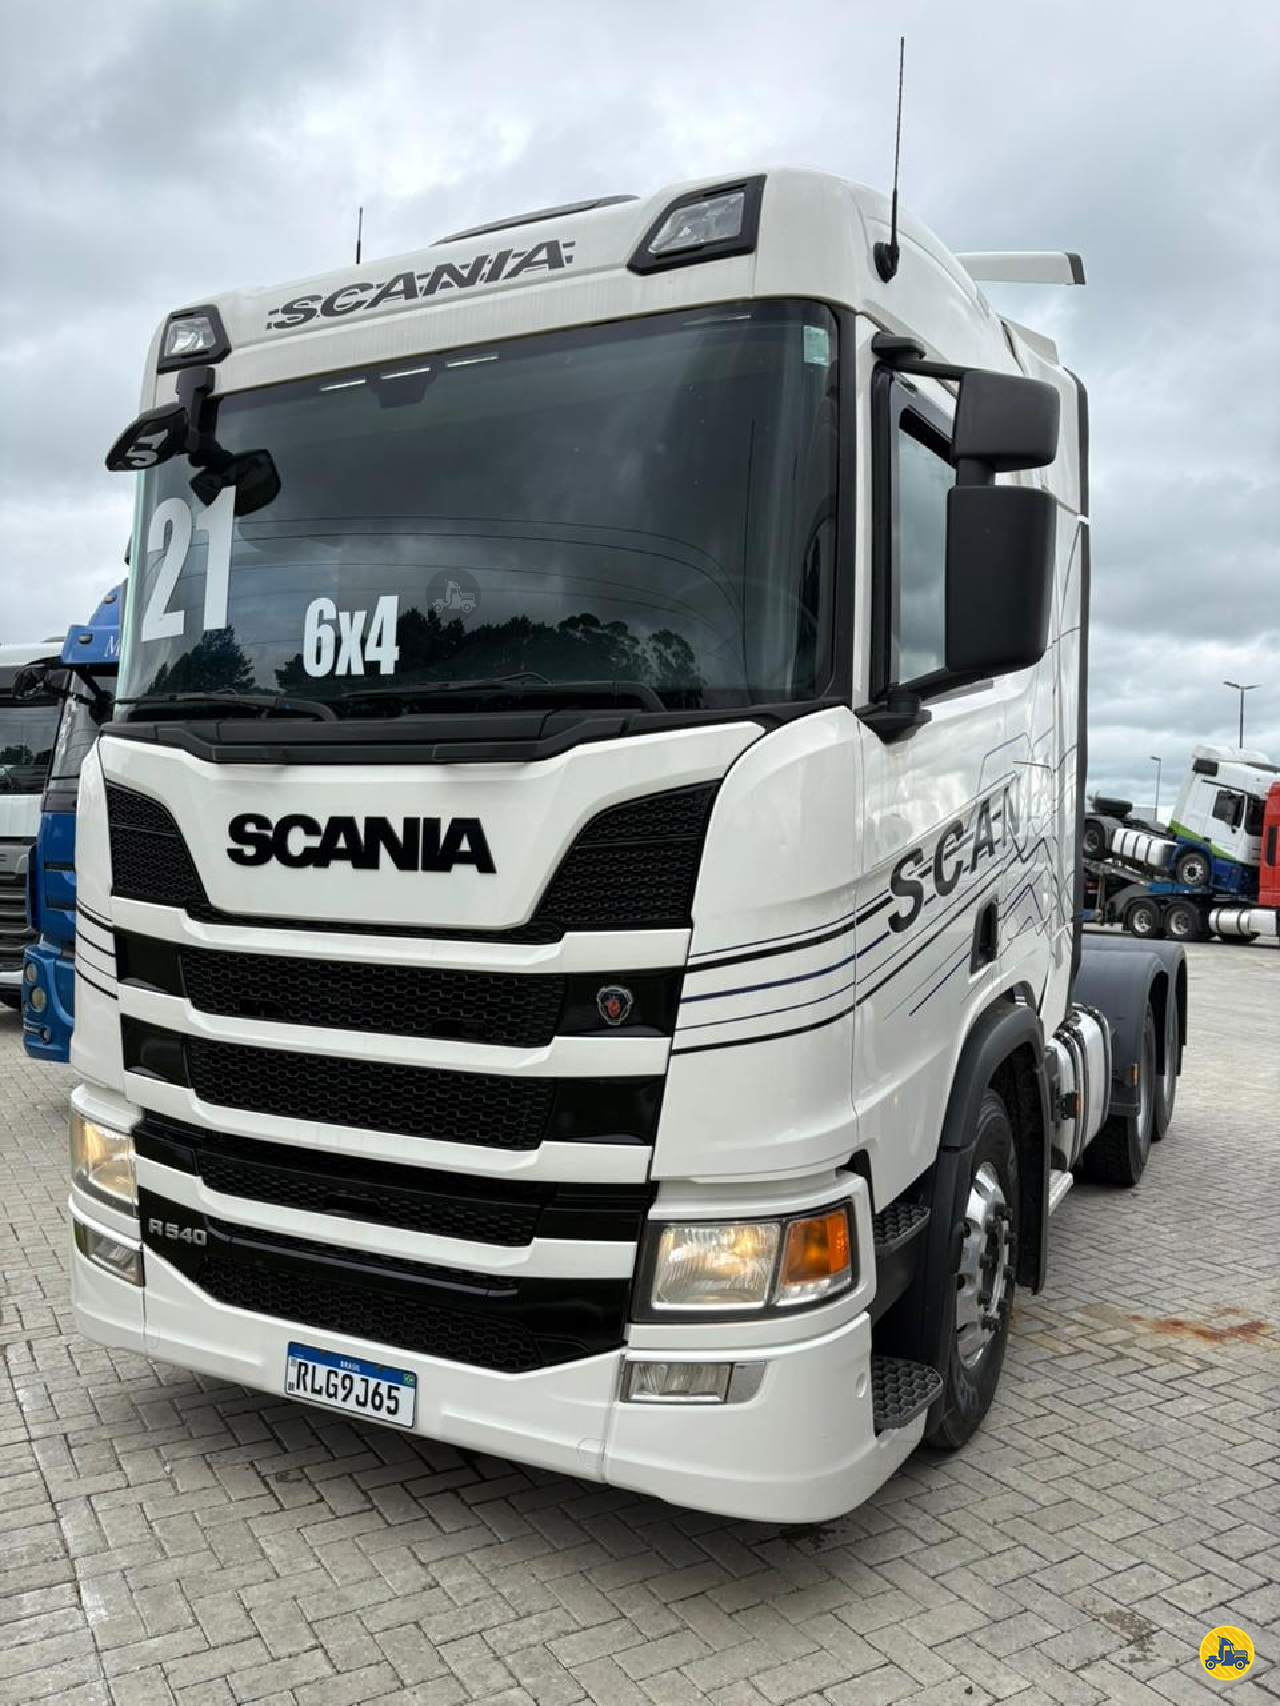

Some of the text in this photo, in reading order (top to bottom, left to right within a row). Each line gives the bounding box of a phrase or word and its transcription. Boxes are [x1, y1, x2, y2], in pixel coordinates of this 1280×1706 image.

[267, 240, 576, 329] SCANIA
[142, 485, 237, 642] 21
[303, 595, 400, 677] 6x4
[227, 813, 497, 874] SCANIA
[296, 1361, 400, 1415] RLG9J65
